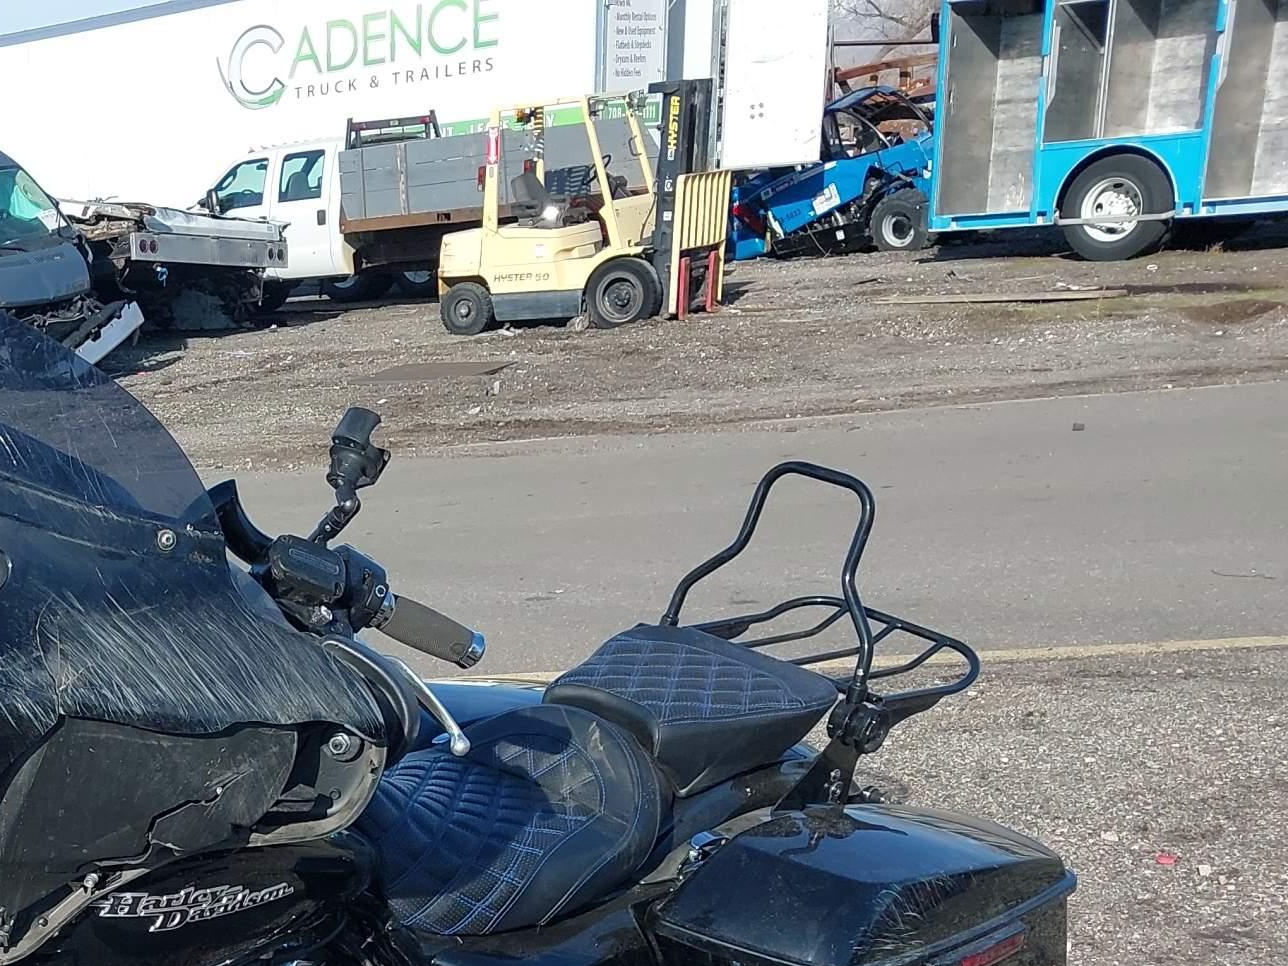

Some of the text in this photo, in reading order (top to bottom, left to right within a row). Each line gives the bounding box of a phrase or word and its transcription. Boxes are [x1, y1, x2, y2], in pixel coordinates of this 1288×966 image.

[216, 0, 500, 110] CADENCE
[294, 57, 495, 100] TRUCK & TRAILERS
[667, 95, 681, 150] HYSTER
[493, 272, 550, 283] HYSTER 50
[92, 884, 243, 918] Harley
